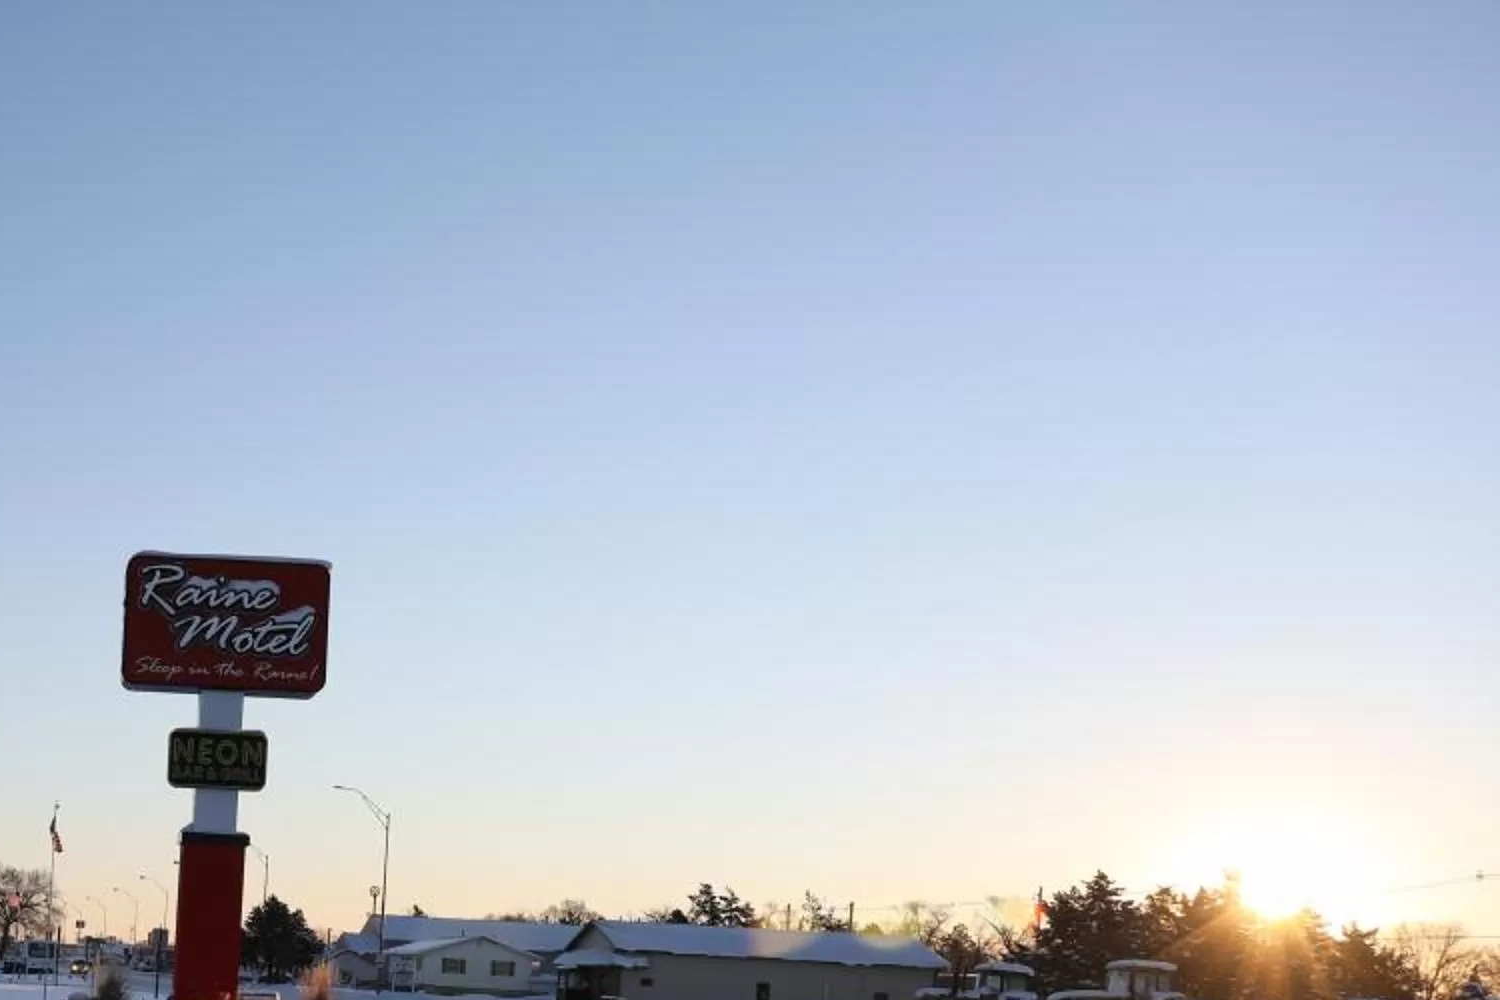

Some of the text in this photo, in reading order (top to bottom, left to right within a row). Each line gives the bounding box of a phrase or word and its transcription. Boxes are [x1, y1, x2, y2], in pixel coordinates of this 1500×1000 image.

[141, 564, 278, 616] Raine
[174, 607, 316, 655] Motel
[172, 735, 263, 768] NEON
